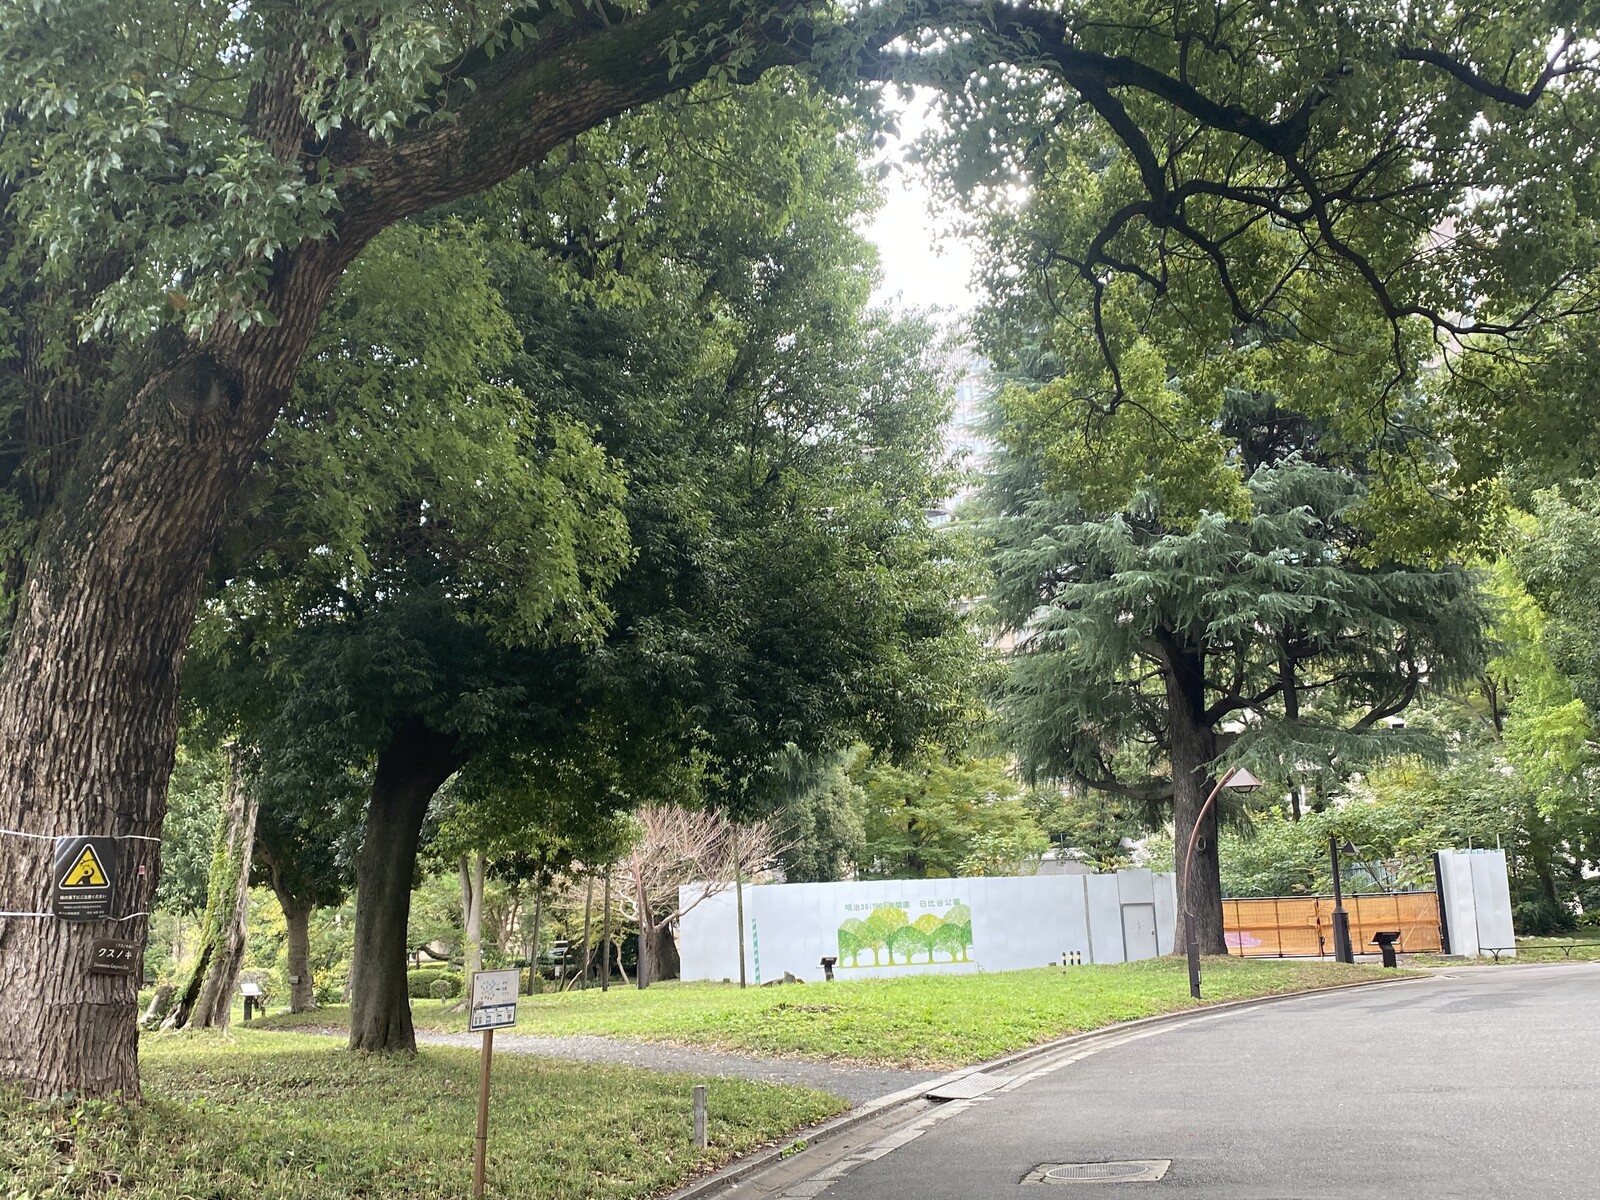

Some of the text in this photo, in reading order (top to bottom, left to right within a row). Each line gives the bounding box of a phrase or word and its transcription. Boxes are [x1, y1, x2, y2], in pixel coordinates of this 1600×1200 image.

[919, 898, 961, 908] 日比谷公園
[98, 947, 132, 960] クスノキ
